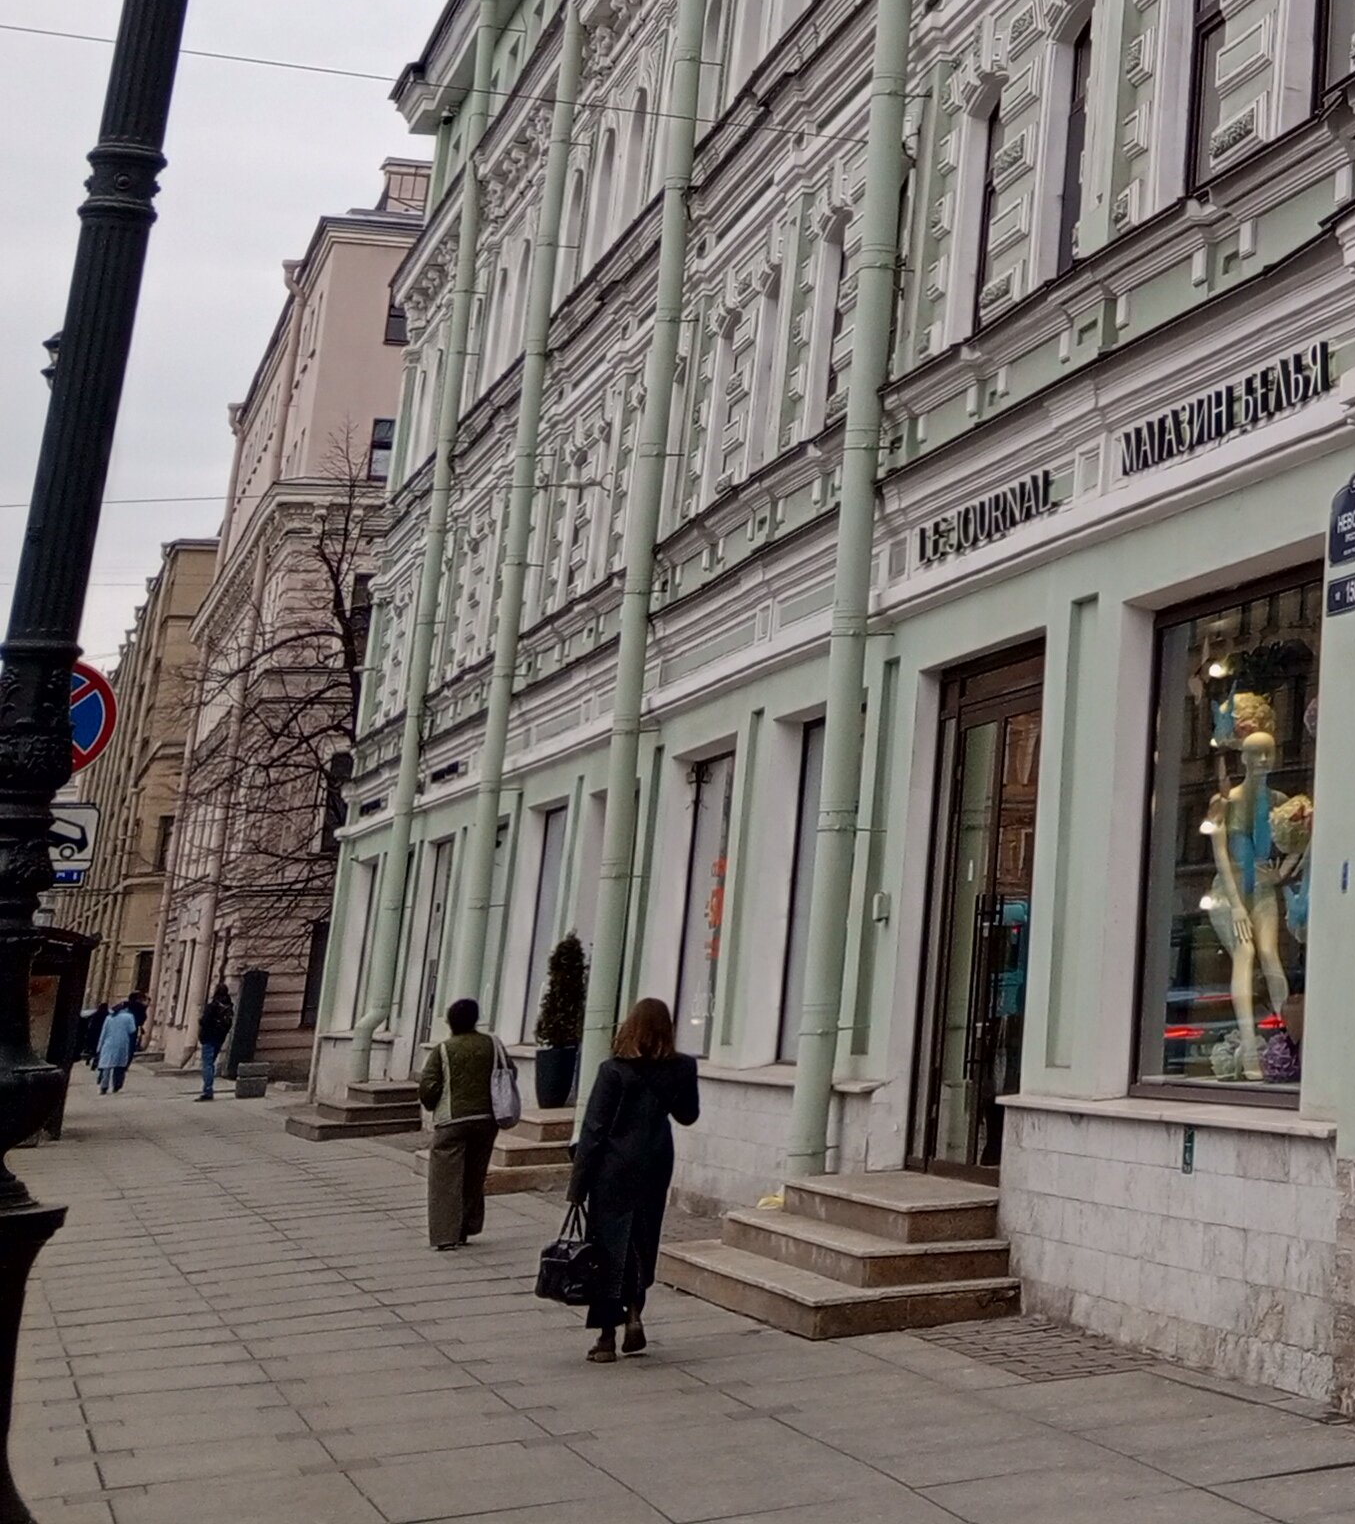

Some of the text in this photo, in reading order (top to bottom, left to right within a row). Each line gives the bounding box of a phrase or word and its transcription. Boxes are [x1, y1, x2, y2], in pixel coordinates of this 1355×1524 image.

[1120, 341, 1326, 476] МАГАЗИН БЕЛЬЯ
[918, 470, 1055, 564] LE JOURNAL
